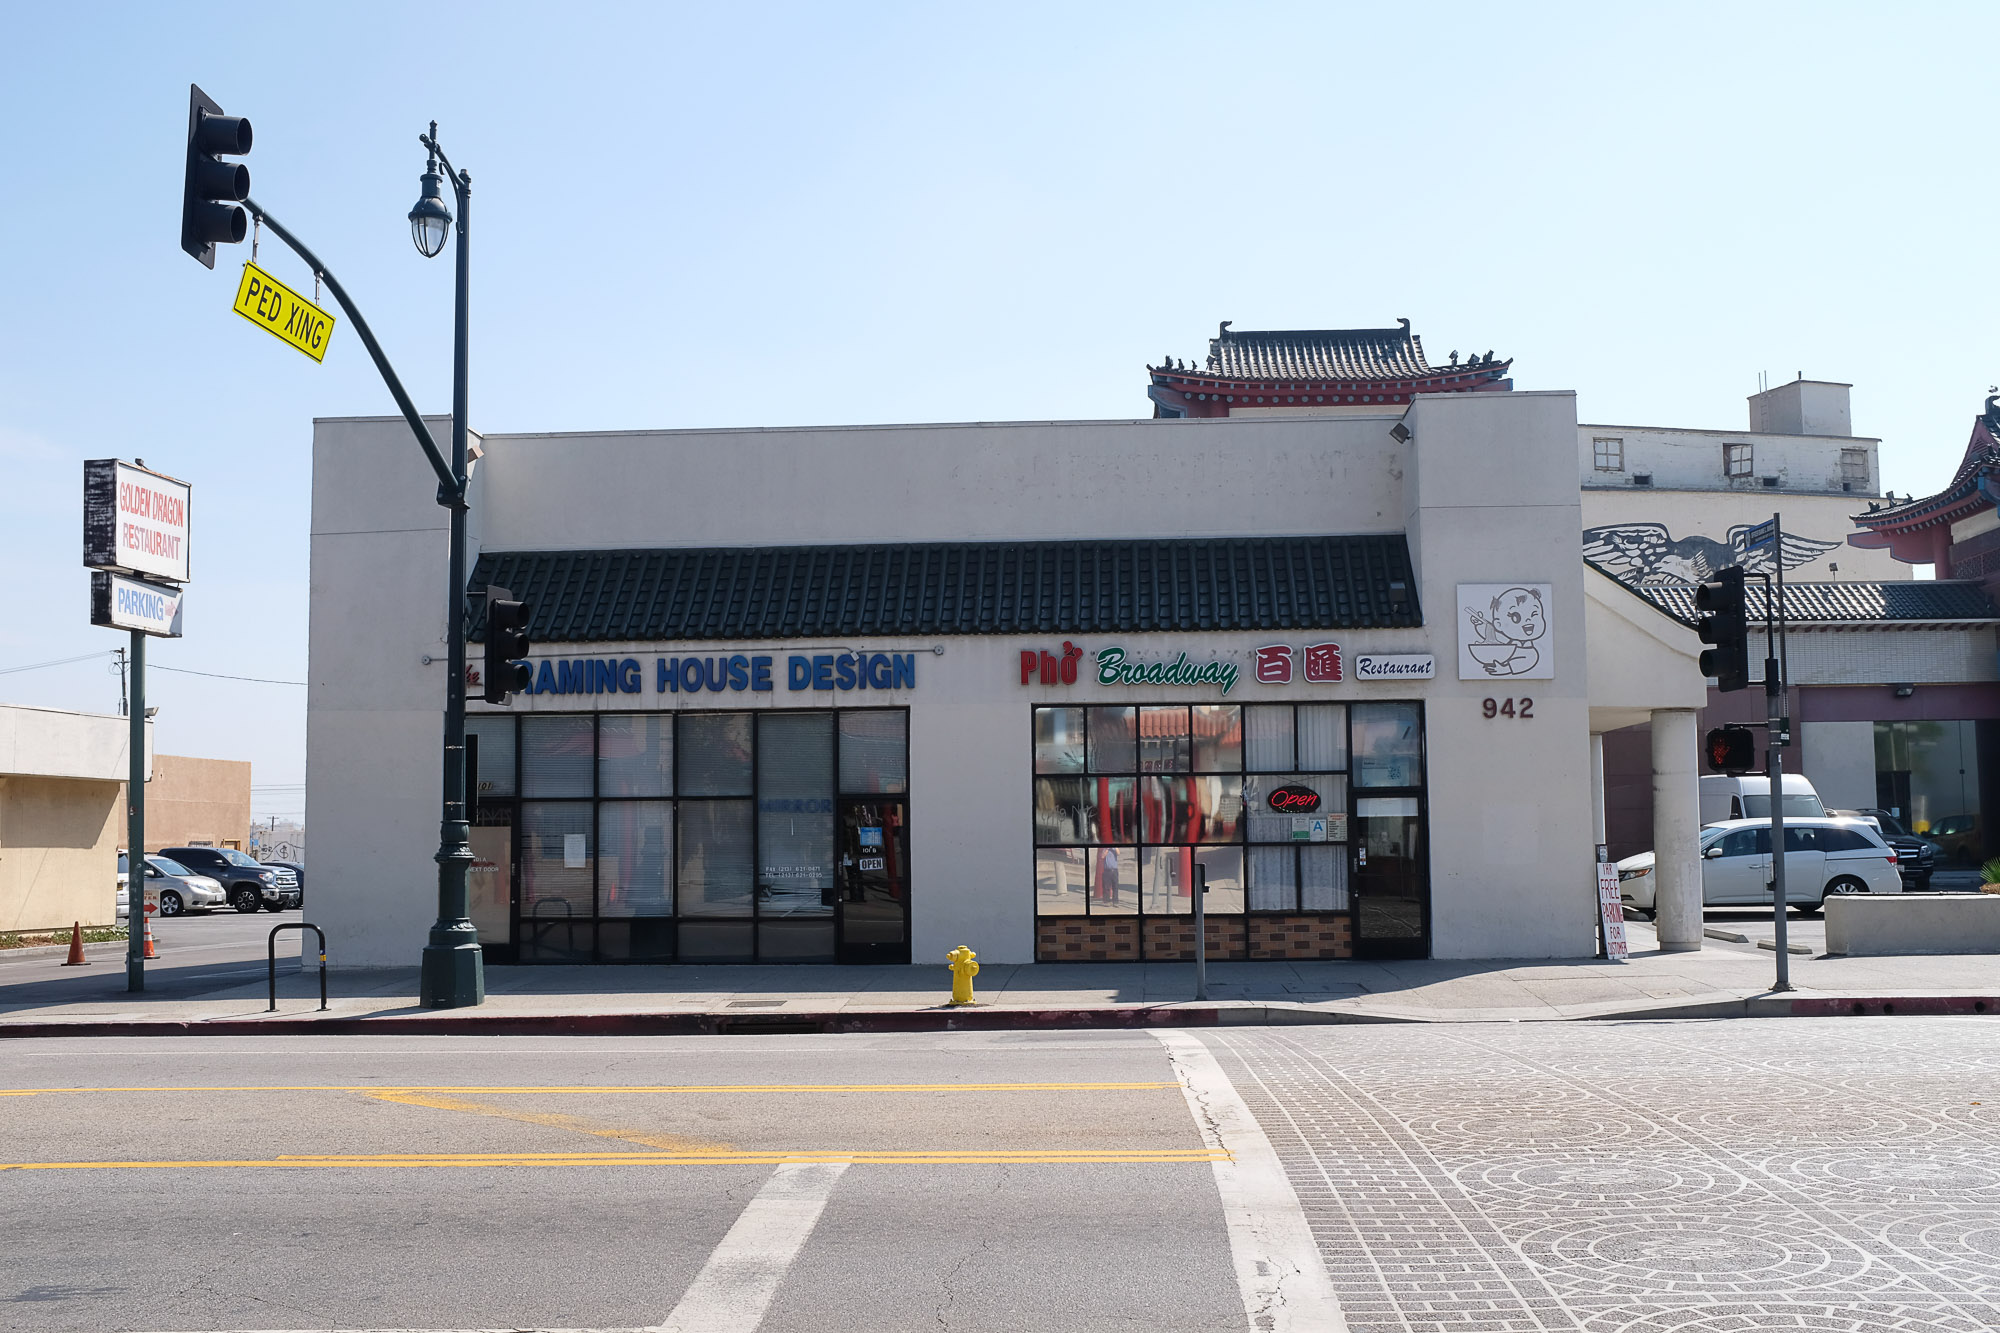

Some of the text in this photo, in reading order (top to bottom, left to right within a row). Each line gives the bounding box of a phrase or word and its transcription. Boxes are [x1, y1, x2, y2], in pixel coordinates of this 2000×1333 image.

[244, 276, 325, 349] PED XING
[119, 481, 184, 528] GOLDEN DRAGON
[122, 522, 181, 561] RESTAURANT
[118, 587, 164, 621] PARKING
[465, 664, 484, 687] he
[656, 655, 773, 693] HOUSE
[788, 653, 915, 691] DESIGN
[1097, 647, 1239, 696] Broadway
[1255, 643, 1344, 684] 百匯
[1359, 657, 1432, 675] Restaurant
[1482, 697, 1535, 719] 942
[1271, 790, 1318, 808] Open
[1313, 820, 1323, 832] A
[861, 859, 882, 870] OPEN
[1600, 878, 1619, 899] FREE
[1602, 902, 1624, 923] PARKING
[1609, 926, 1622, 940] FOR
